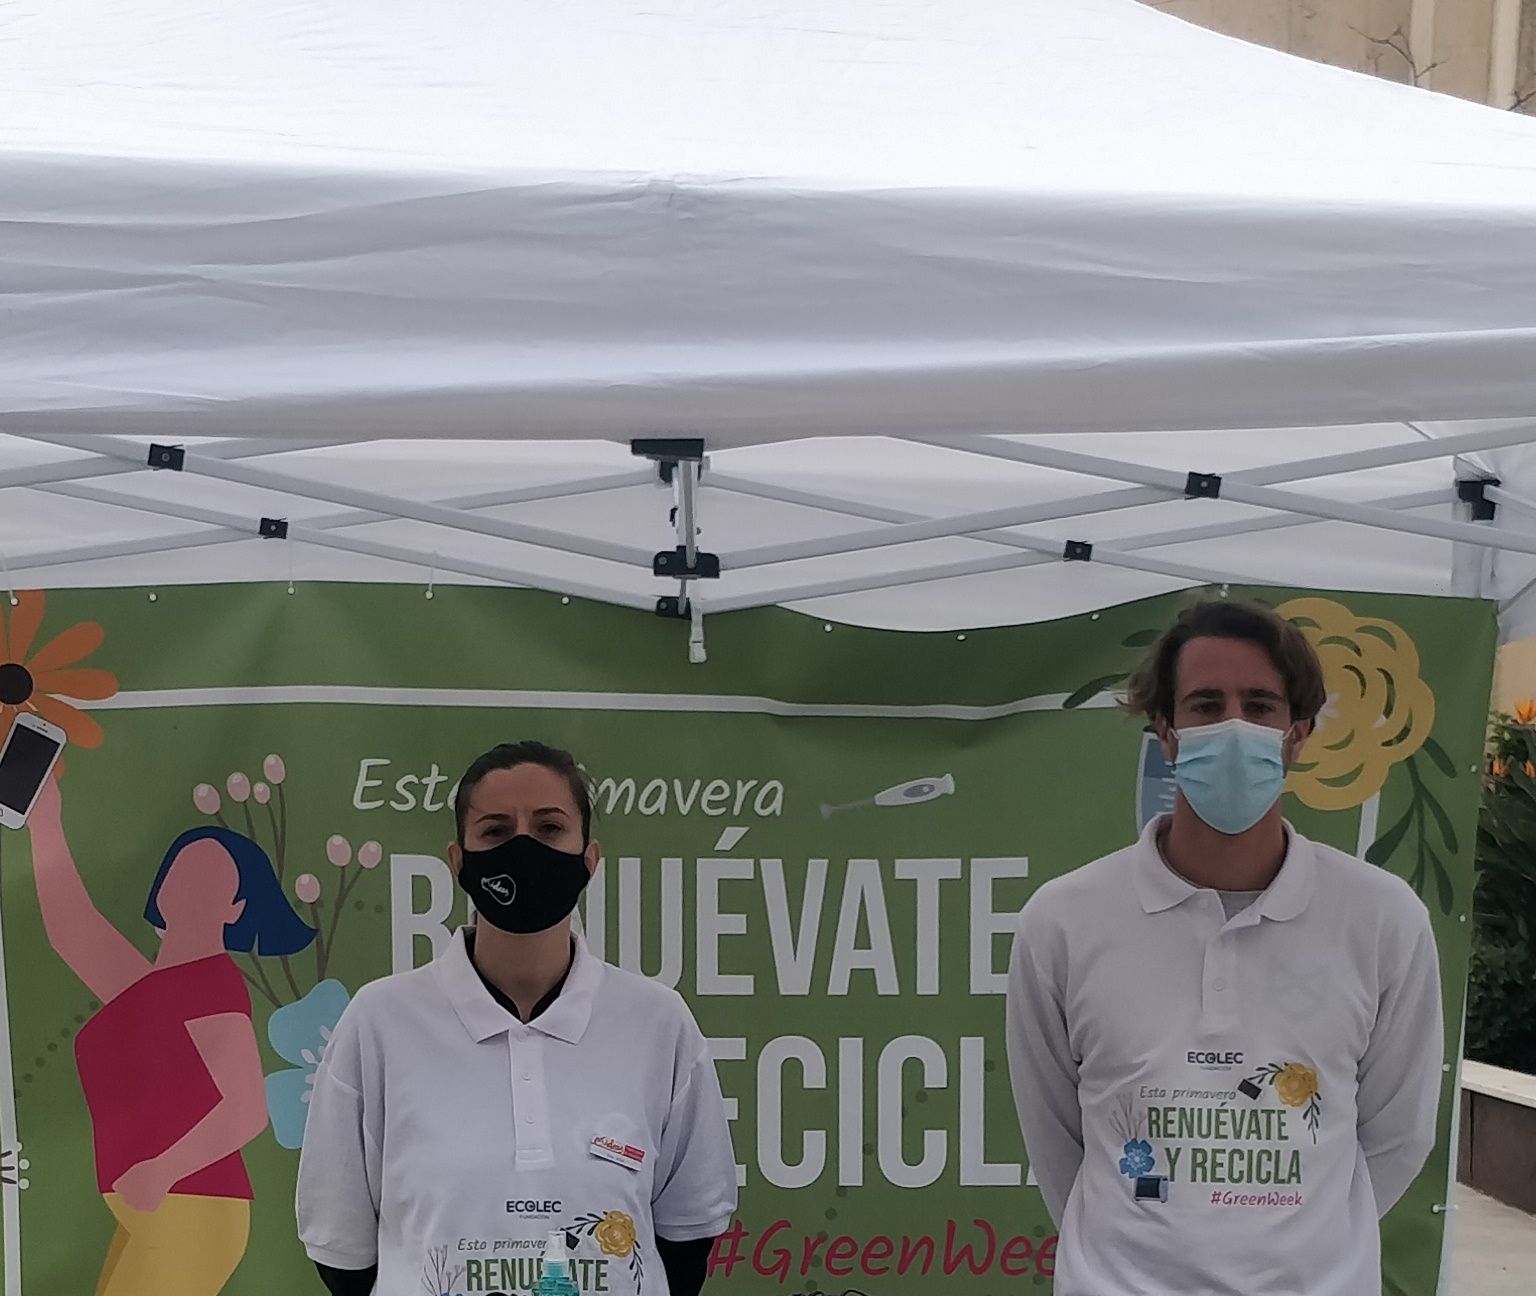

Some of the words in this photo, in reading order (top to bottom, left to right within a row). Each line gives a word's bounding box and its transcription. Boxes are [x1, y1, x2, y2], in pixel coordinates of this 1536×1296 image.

[1187, 1051, 1244, 1065] ECOLEC
[1148, 1102, 1289, 1141] RENUÉVATE
[1164, 1147, 1182, 1183] Y
[1190, 1149, 1302, 1185] RECICLA
[506, 1200, 562, 1213] ECOLEC
[492, 1239, 547, 1253] primaver
[707, 1219, 1059, 1285] #GreenWee
